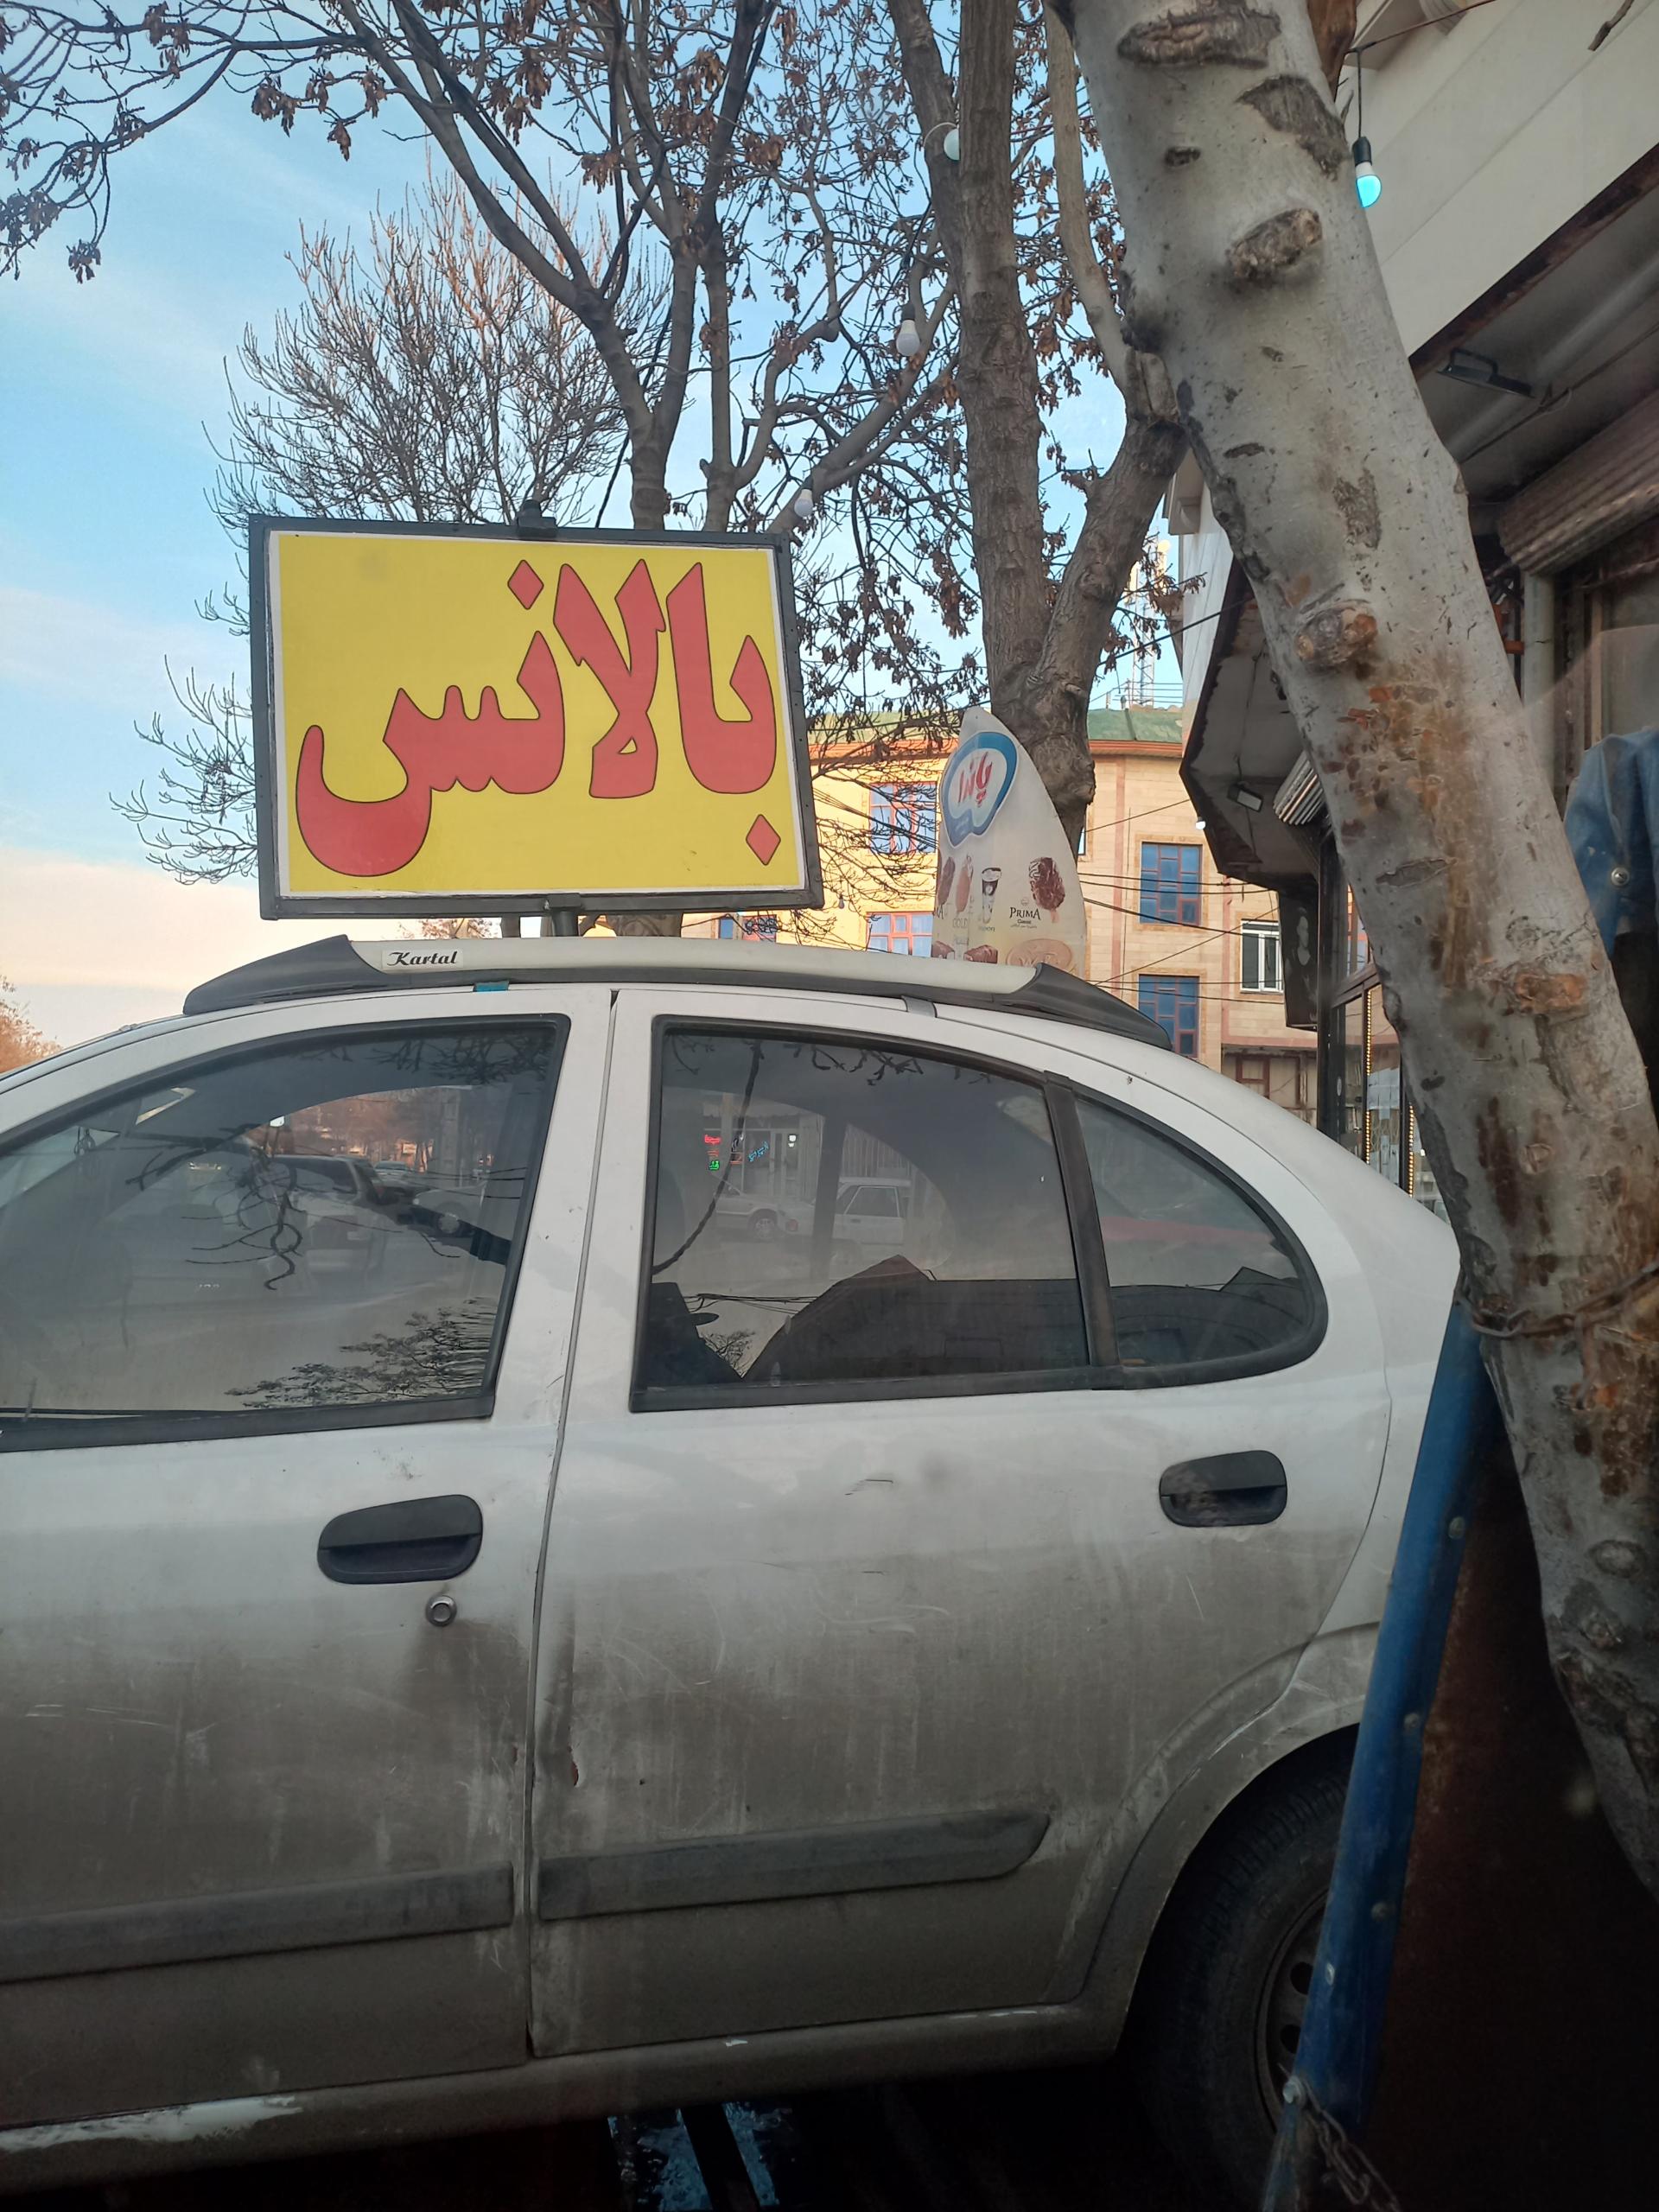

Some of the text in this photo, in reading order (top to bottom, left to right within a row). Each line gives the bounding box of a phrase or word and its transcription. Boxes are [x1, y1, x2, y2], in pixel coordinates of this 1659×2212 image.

[296, 558, 781, 877] بالانس
[1009, 906, 1041, 920] PRIMA
[387, 950, 458, 966] Kartal
